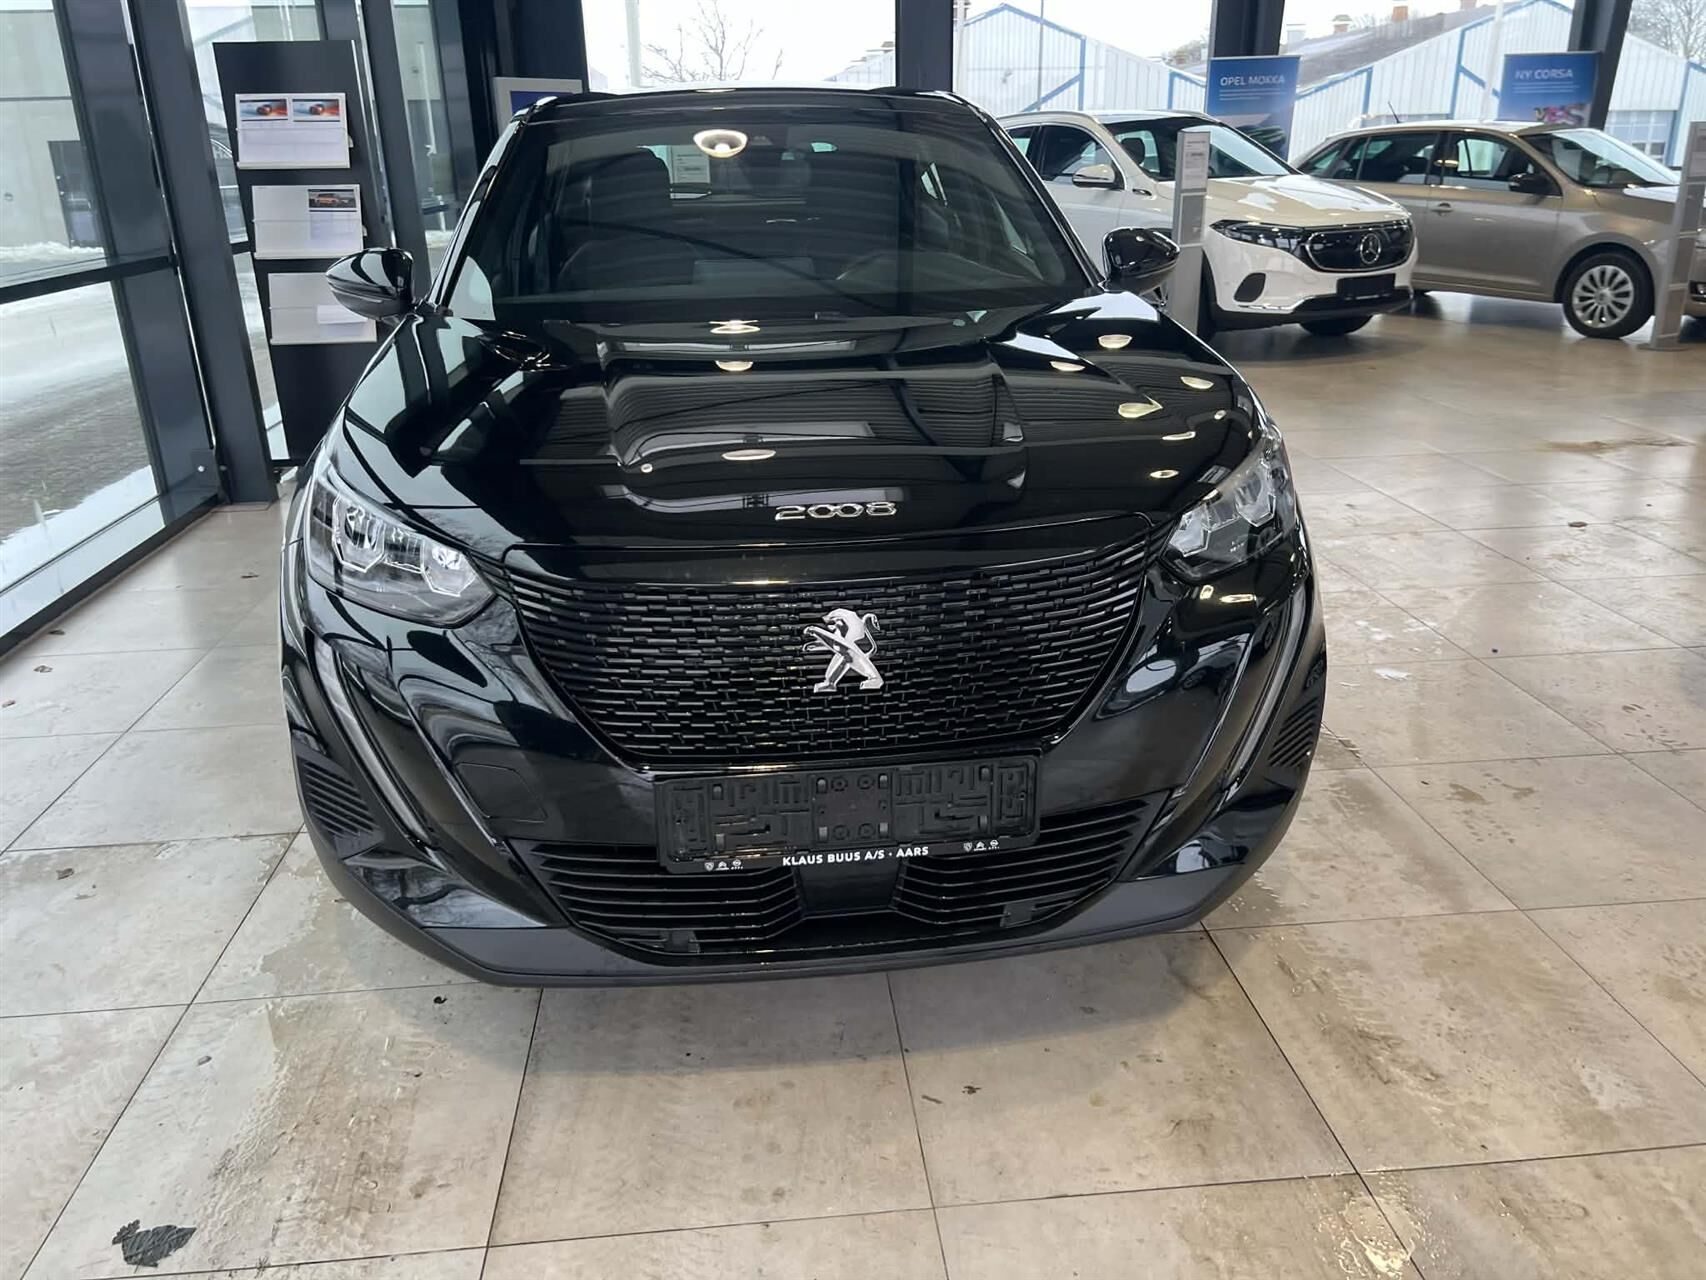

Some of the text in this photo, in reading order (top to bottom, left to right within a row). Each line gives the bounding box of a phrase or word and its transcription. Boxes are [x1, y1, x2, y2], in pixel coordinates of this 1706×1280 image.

[1220, 75, 1285, 87] OPEL MOKKA
[1534, 68, 1573, 80] CORSA
[775, 501, 897, 521] 2008
[782, 846, 929, 867] KLAUS BUUS A/S AARS
